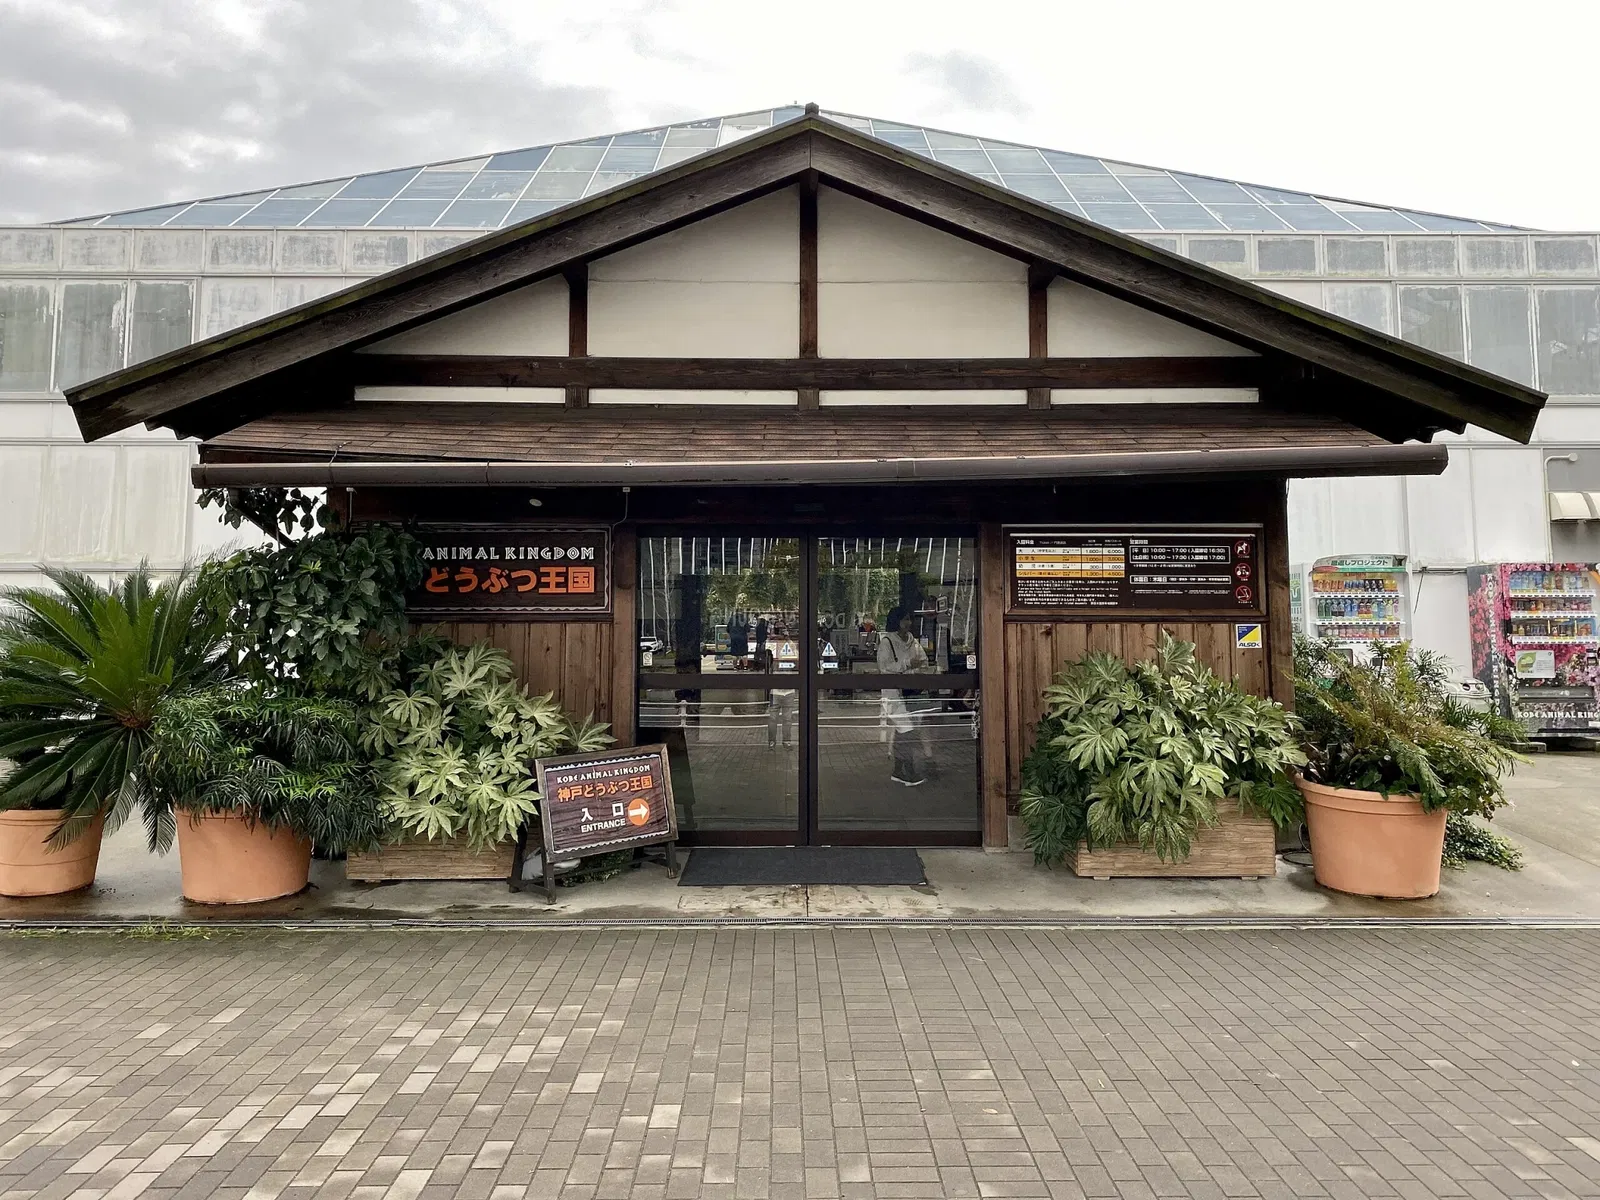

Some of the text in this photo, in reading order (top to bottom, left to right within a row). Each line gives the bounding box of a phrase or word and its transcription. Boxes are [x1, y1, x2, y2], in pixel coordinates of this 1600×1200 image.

[422, 546, 595, 561] ANIMAL KINGDOM
[425, 566, 595, 593] どうぶつ王国
[556, 764, 650, 784] KOBE ANIMAL KINGDOM
[557, 775, 653, 802] 神戸どうぶつ王国
[581, 818, 626, 833] ENTRANCE
